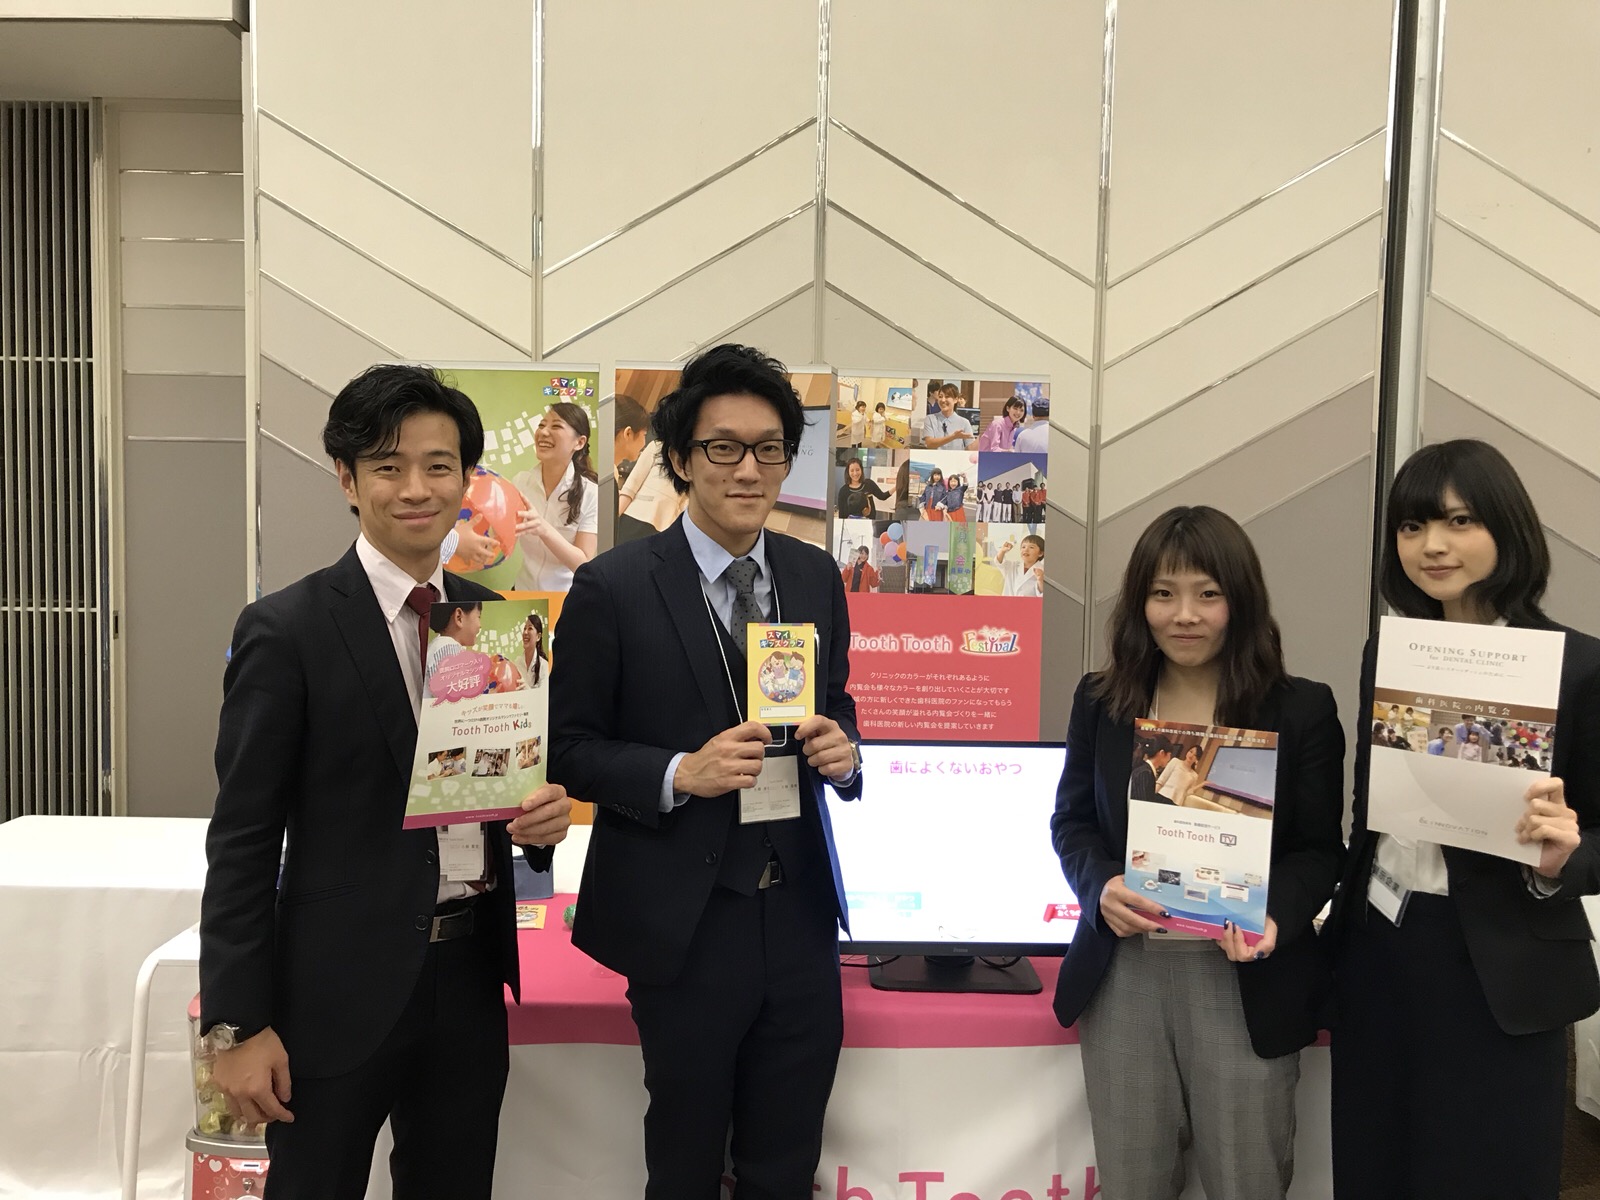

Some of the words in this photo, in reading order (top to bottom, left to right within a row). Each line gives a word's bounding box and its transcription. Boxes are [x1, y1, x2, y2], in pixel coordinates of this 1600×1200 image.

[551, 377, 587, 388] スマイル
[543, 386, 594, 396] キッズクラブ
[767, 630, 797, 640] スマイル
[760, 639, 805, 648] キッズクラブ
[850, 633, 898, 651] Tooth
[902, 635, 951, 652] Tooth
[962, 631, 1019, 654] Festival
[1409, 642, 1465, 656] OPENING
[1470, 649, 1528, 663] SUPPORT
[1443, 656, 1473, 664] DENTAL
[1476, 659, 1504, 667] CLINIC
[870, 672, 990, 682] クリニックのカラーがそれぞれあるように
[446, 674, 481, 694] 大好評
[849, 683, 1010, 694] 内覧会も様々なカラーを創り出していくことが大切です
[853, 695, 1013, 706] 域の方に新しくできた歯科医院のファンになってもらう
[1415, 697, 1510, 716] 歯科医院の内覧会
[861, 708, 997, 719] たくさんの笑顔が溢れる内覧会づくりを一緒に
[452, 725, 480, 736] Tooth
[483, 722, 509, 734] Tooth
[513, 718, 532, 730] Kids
[863, 720, 994, 731] 歯科医院の新しい内覧会を提案していきます
[889, 760, 1022, 775] 歯によくないおやつ
[1157, 826, 1185, 838] Tooth
[1187, 830, 1215, 843] Tooth
[1222, 835, 1234, 844] TV
